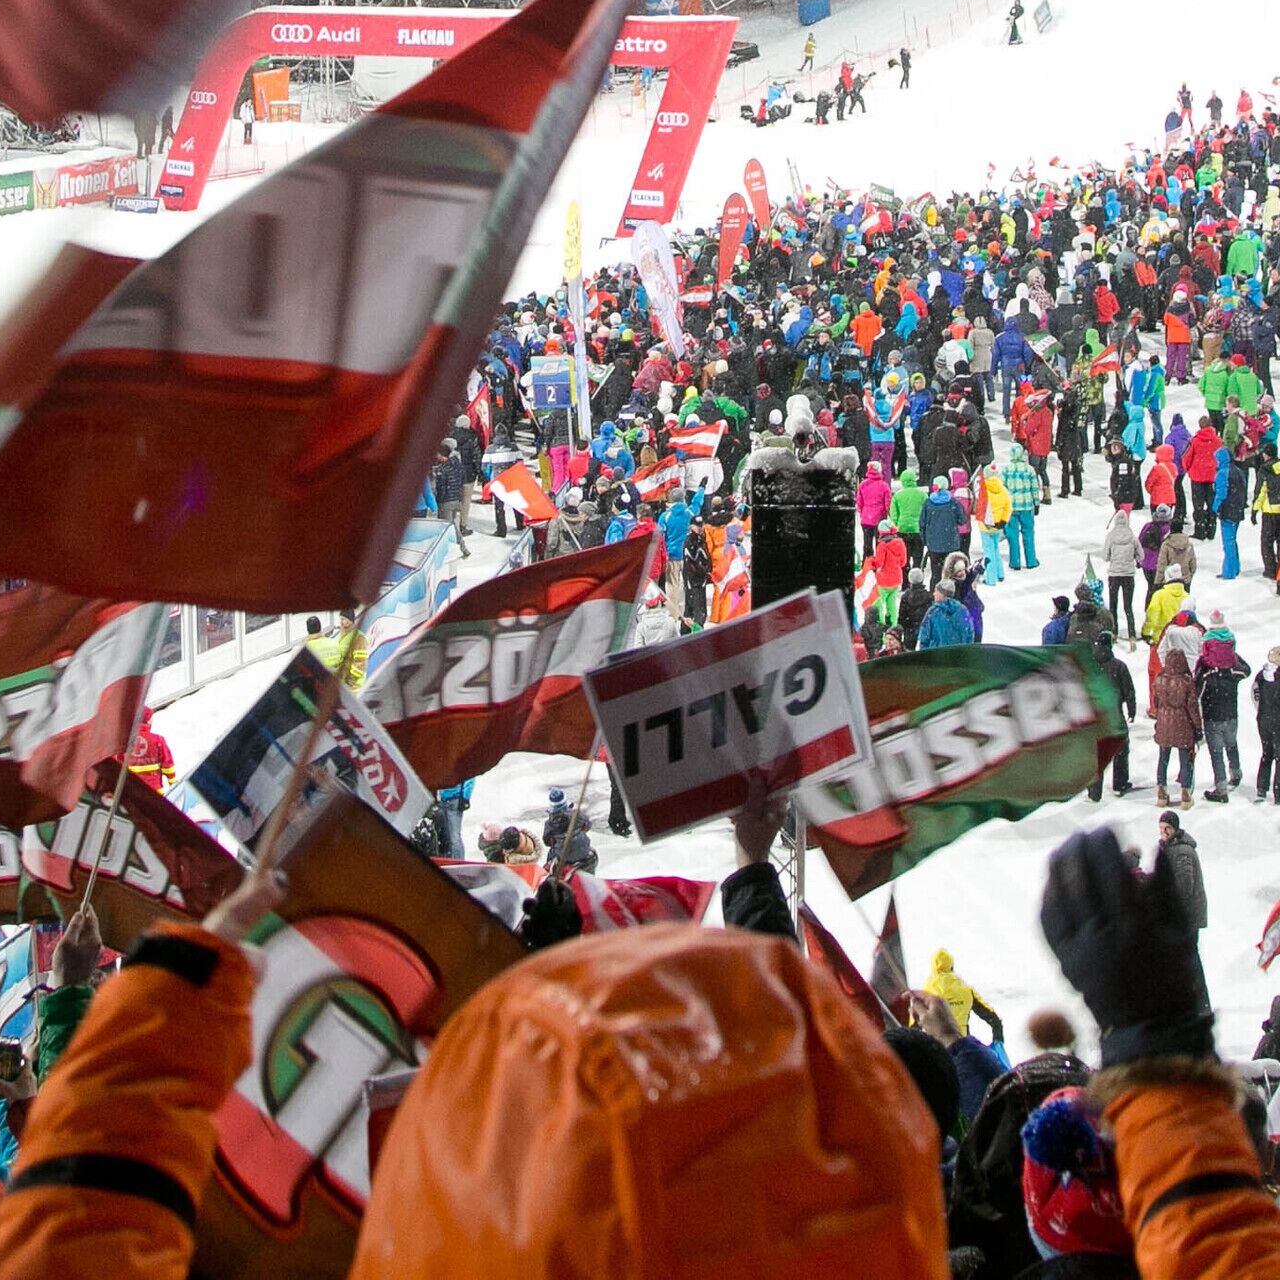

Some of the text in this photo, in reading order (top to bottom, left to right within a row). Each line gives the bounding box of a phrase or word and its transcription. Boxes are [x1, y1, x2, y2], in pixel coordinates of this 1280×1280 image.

[317, 26, 455, 46] Audi FLACHAU
[614, 37, 667, 52] attro
[59, 170, 110, 200] Kronen
[546, 384, 556, 403] 2
[623, 653, 828, 778] GALLI
